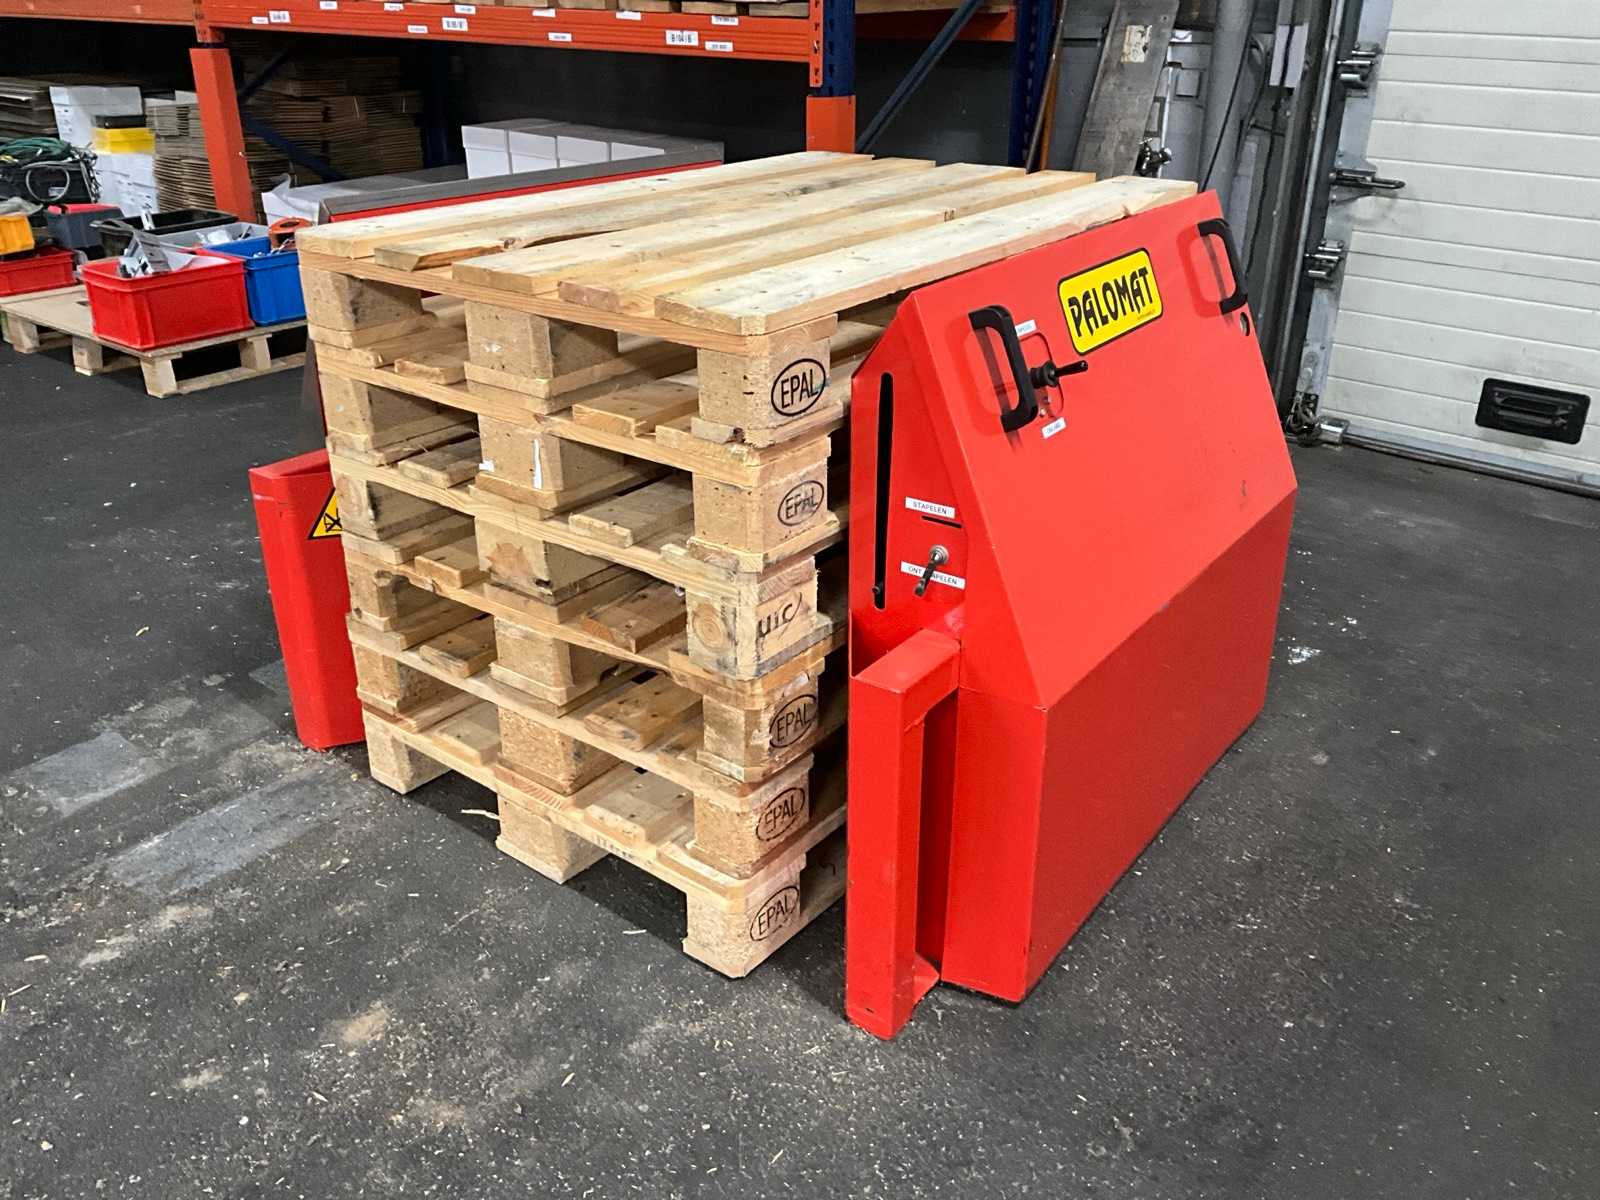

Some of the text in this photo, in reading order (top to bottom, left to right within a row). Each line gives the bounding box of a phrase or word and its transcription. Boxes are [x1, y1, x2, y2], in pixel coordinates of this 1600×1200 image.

[1067, 266, 1153, 338] PALOMAT
[780, 369, 819, 410] EPAL
[785, 488, 819, 520] EPAL
[912, 500, 947, 515] STAPELEN
[908, 565, 958, 585] ONTAPELEN
[776, 702, 817, 743] EPAL
[764, 793, 799, 833] EPAL
[757, 893, 797, 941] EPAL
